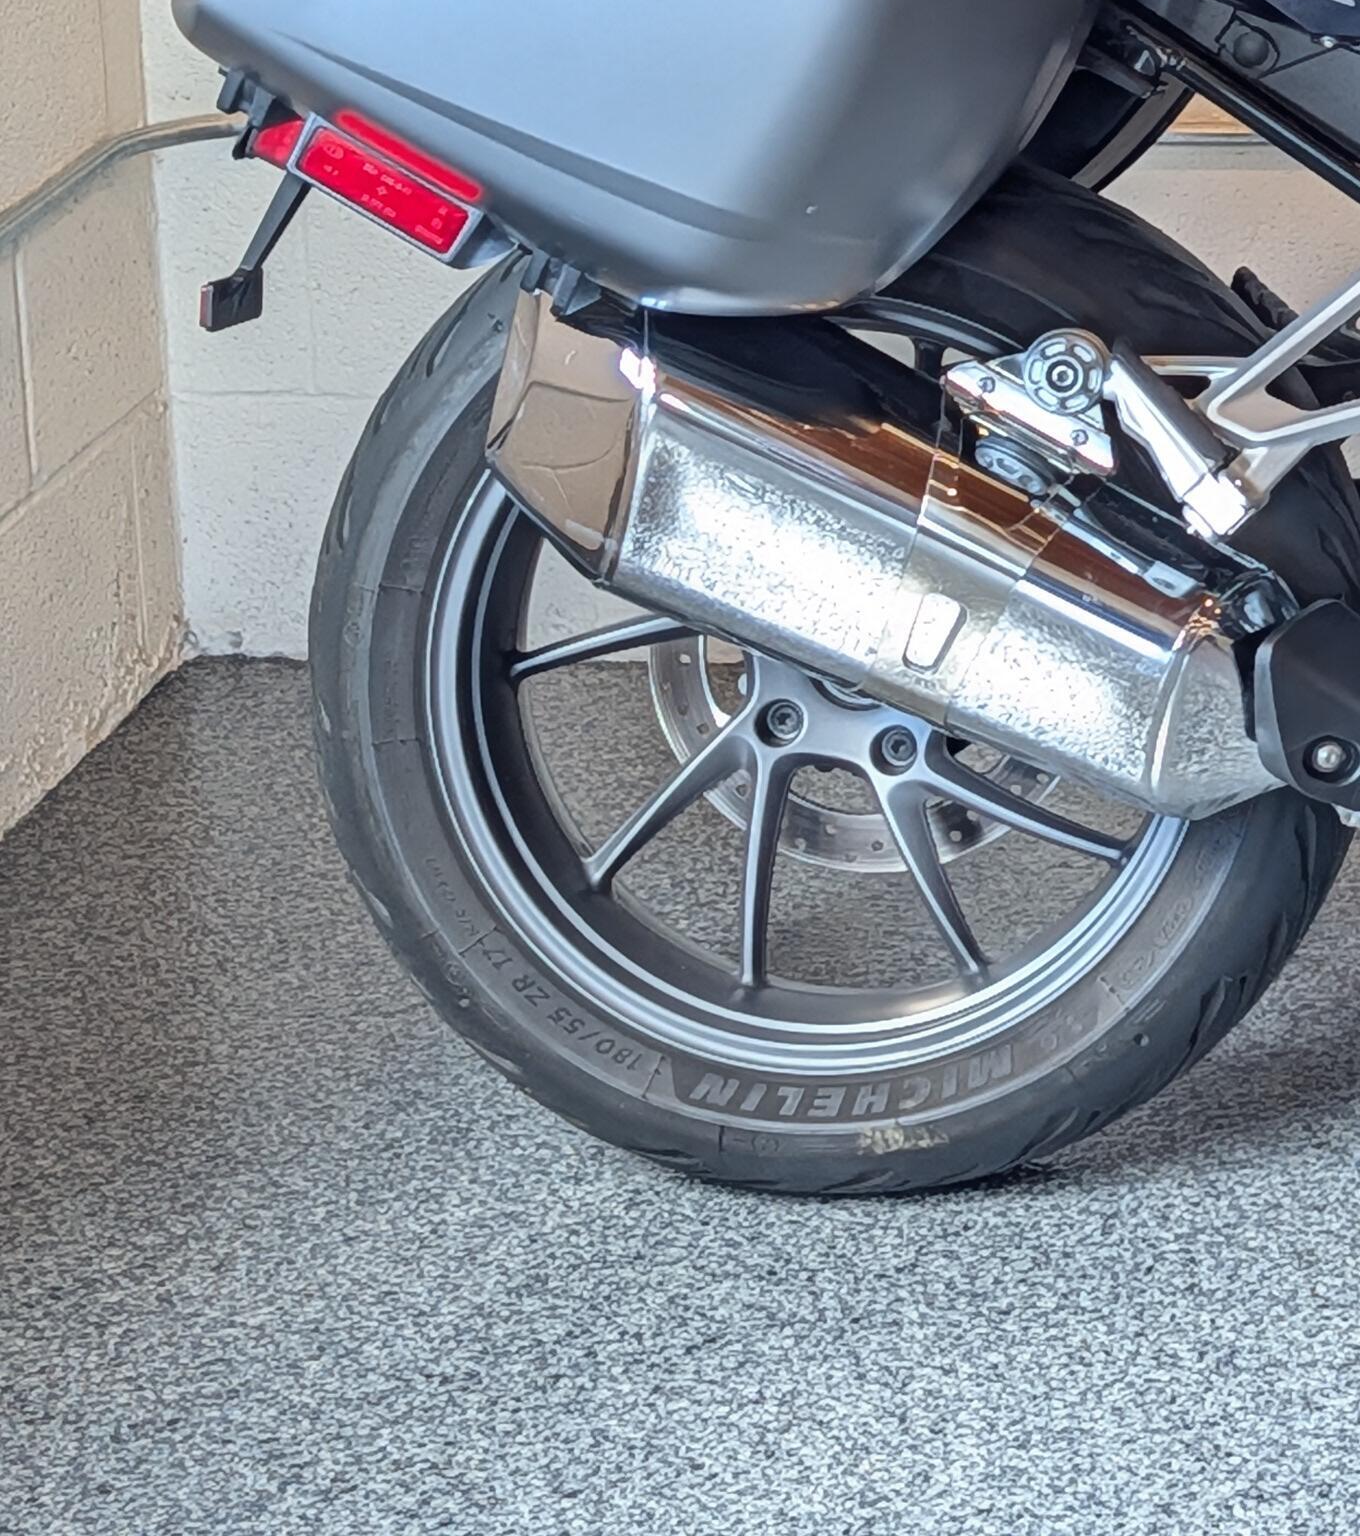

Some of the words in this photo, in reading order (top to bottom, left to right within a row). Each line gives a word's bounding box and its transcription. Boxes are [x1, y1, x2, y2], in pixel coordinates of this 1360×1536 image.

[482, 946, 513, 969] 17
[512, 974, 550, 1007] ZR
[547, 1007, 643, 1071] 180/55
[690, 1044, 1014, 1117] MICHELIN
